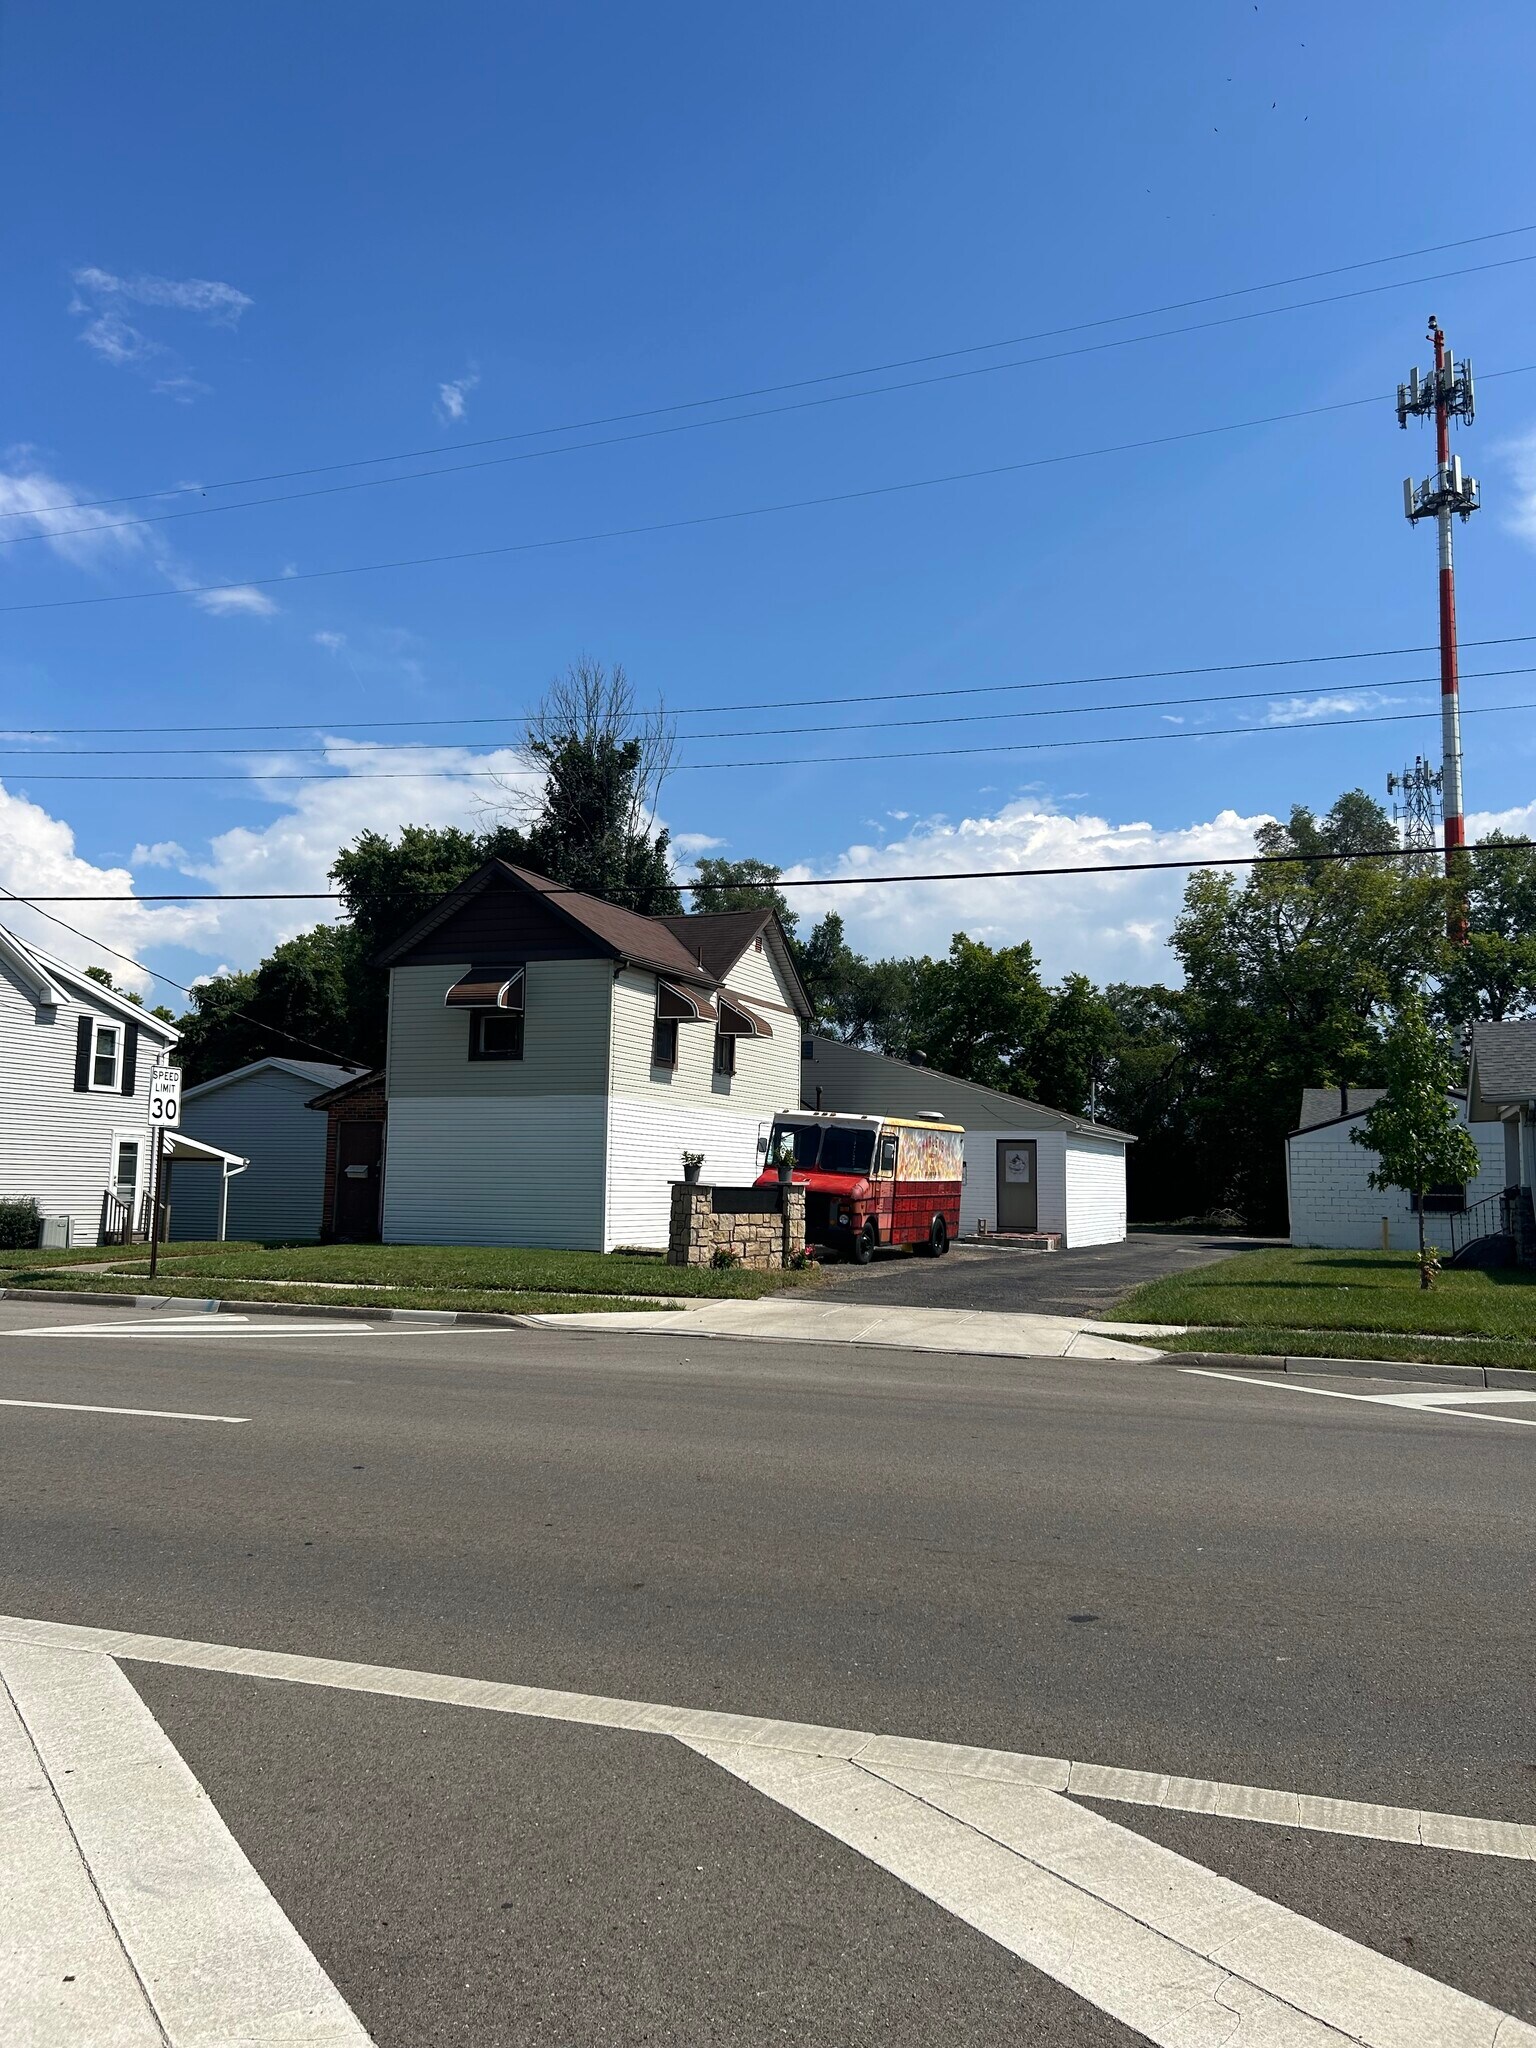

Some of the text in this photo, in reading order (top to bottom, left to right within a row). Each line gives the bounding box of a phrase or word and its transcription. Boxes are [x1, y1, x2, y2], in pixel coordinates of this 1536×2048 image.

[153, 1070, 179, 1081] SPEED
[155, 1083, 175, 1093] LIMIT
[152, 1098, 177, 1120] 30
